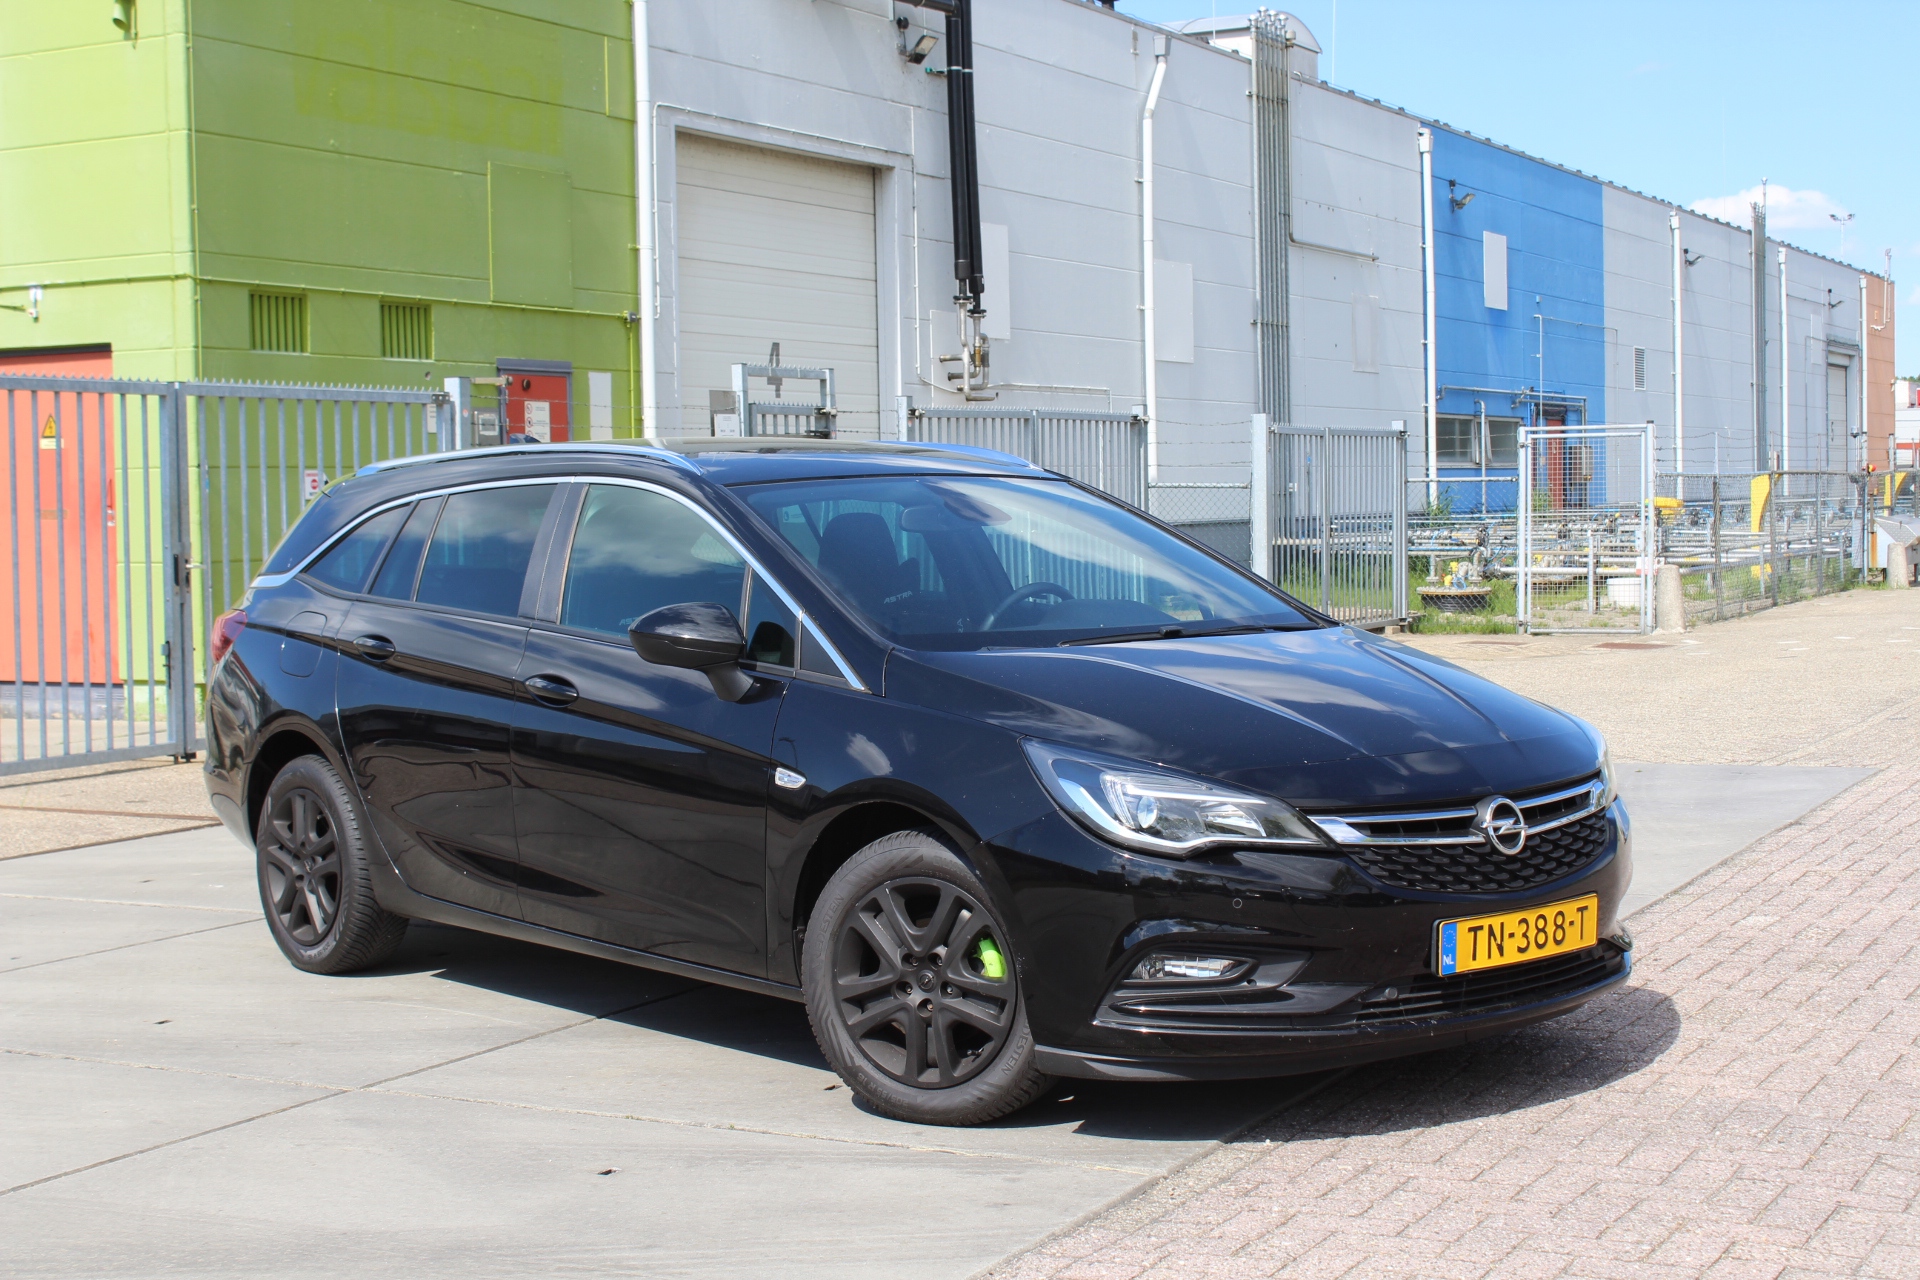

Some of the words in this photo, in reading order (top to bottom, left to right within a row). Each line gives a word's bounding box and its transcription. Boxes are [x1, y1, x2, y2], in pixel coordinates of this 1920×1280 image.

[883, 590, 913, 605] ASTRA
[1467, 905, 1589, 962] TN-388-T
[1443, 954, 1455, 966] NL
